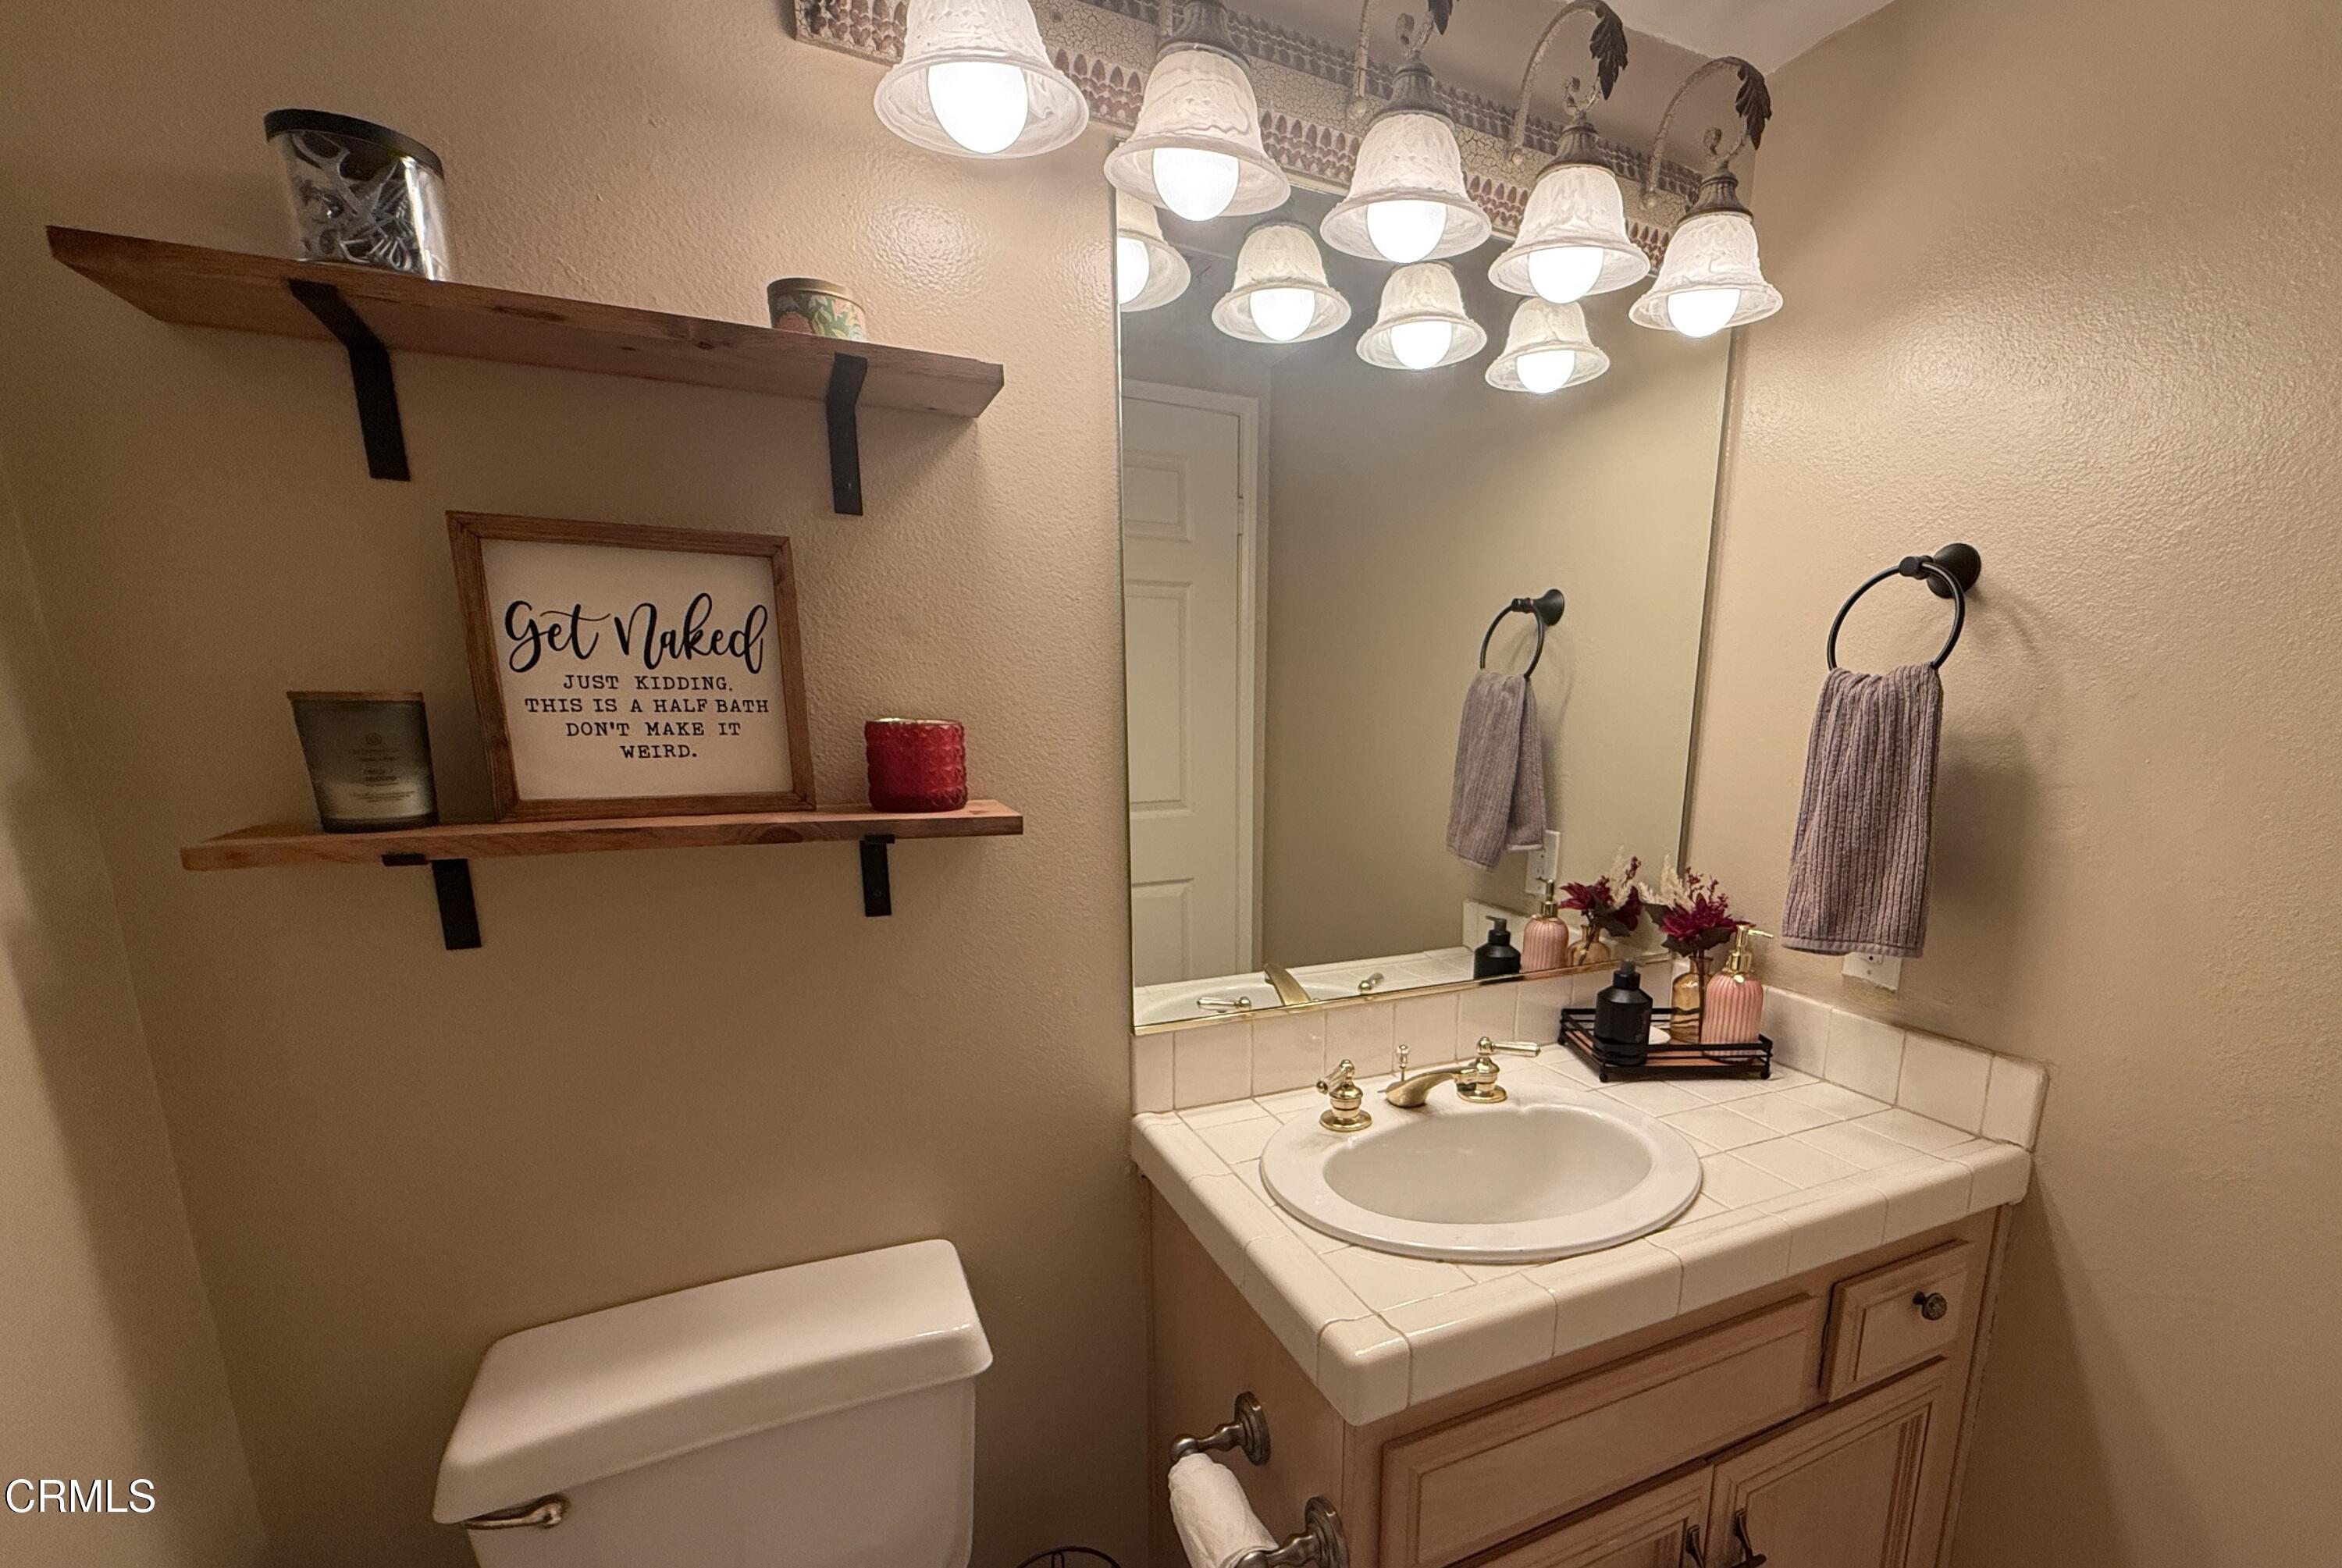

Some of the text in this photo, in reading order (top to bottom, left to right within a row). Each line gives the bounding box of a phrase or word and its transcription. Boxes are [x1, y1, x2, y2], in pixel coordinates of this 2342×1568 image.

[614, 592, 768, 674] Naked
[563, 674, 733, 691] JUST KIDDING.
[525, 699, 769, 713] THIS IS A HALF BATH
[566, 722, 741, 737] DON'T MAKE IT
[620, 745, 697, 759] WEIRD.
